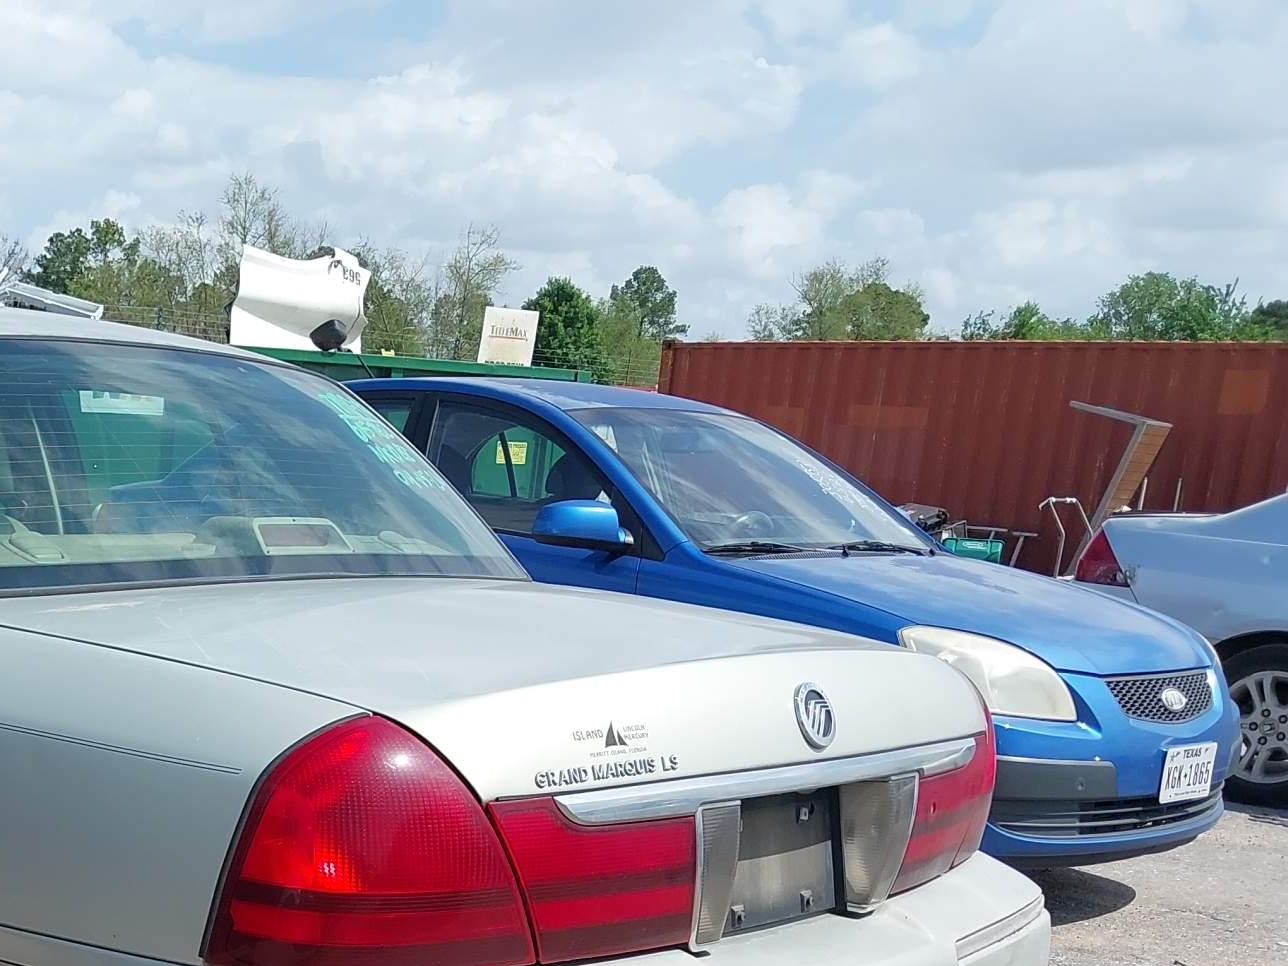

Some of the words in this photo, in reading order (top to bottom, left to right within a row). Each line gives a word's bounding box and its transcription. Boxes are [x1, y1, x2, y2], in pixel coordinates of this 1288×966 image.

[572, 729, 604, 741] ISLAND
[1183, 747, 1202, 759] TEXAS
[534, 766, 589, 789] GRAND
[591, 757, 656, 781] MARQUIS
[660, 754, 679, 772] LS
